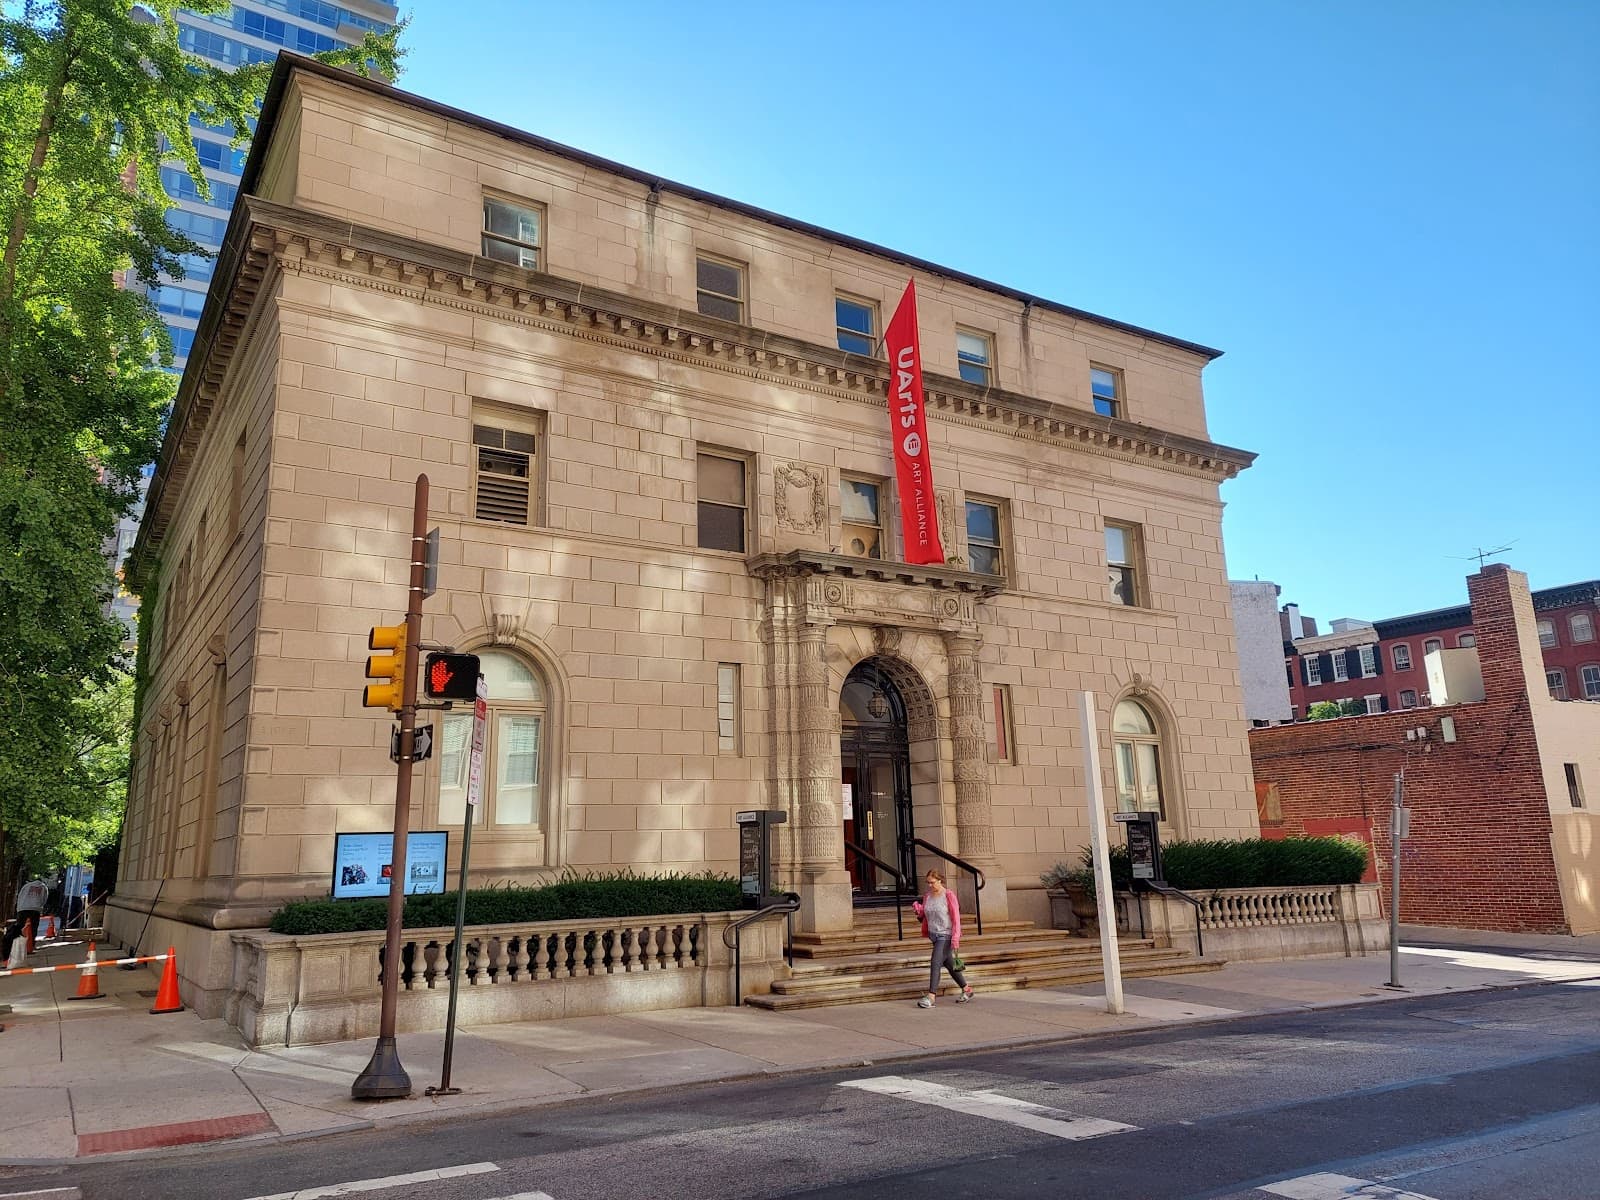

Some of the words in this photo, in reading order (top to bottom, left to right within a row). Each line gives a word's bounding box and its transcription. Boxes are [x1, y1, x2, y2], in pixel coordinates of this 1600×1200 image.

[897, 346, 917, 428] UArts
[912, 462, 922, 485] ART
[914, 489, 928, 546] ALLIANCE
